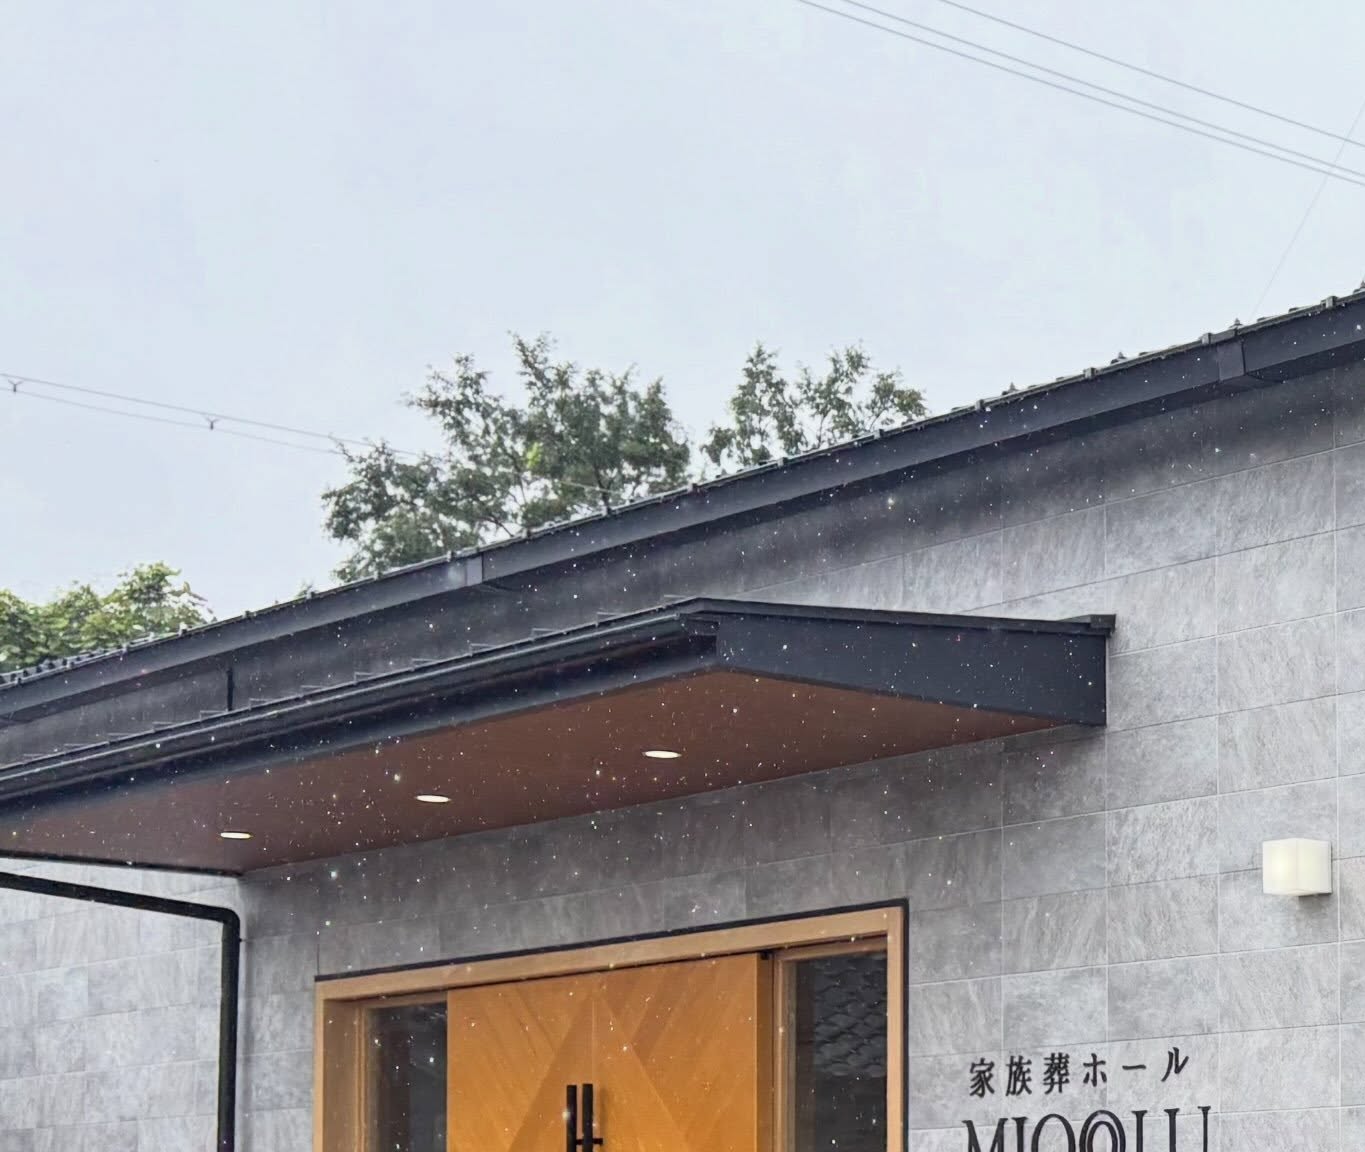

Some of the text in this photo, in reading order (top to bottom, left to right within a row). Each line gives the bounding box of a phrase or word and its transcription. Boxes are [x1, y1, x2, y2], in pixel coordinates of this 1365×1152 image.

[969, 1047, 1189, 1098] 家族葬ホール
